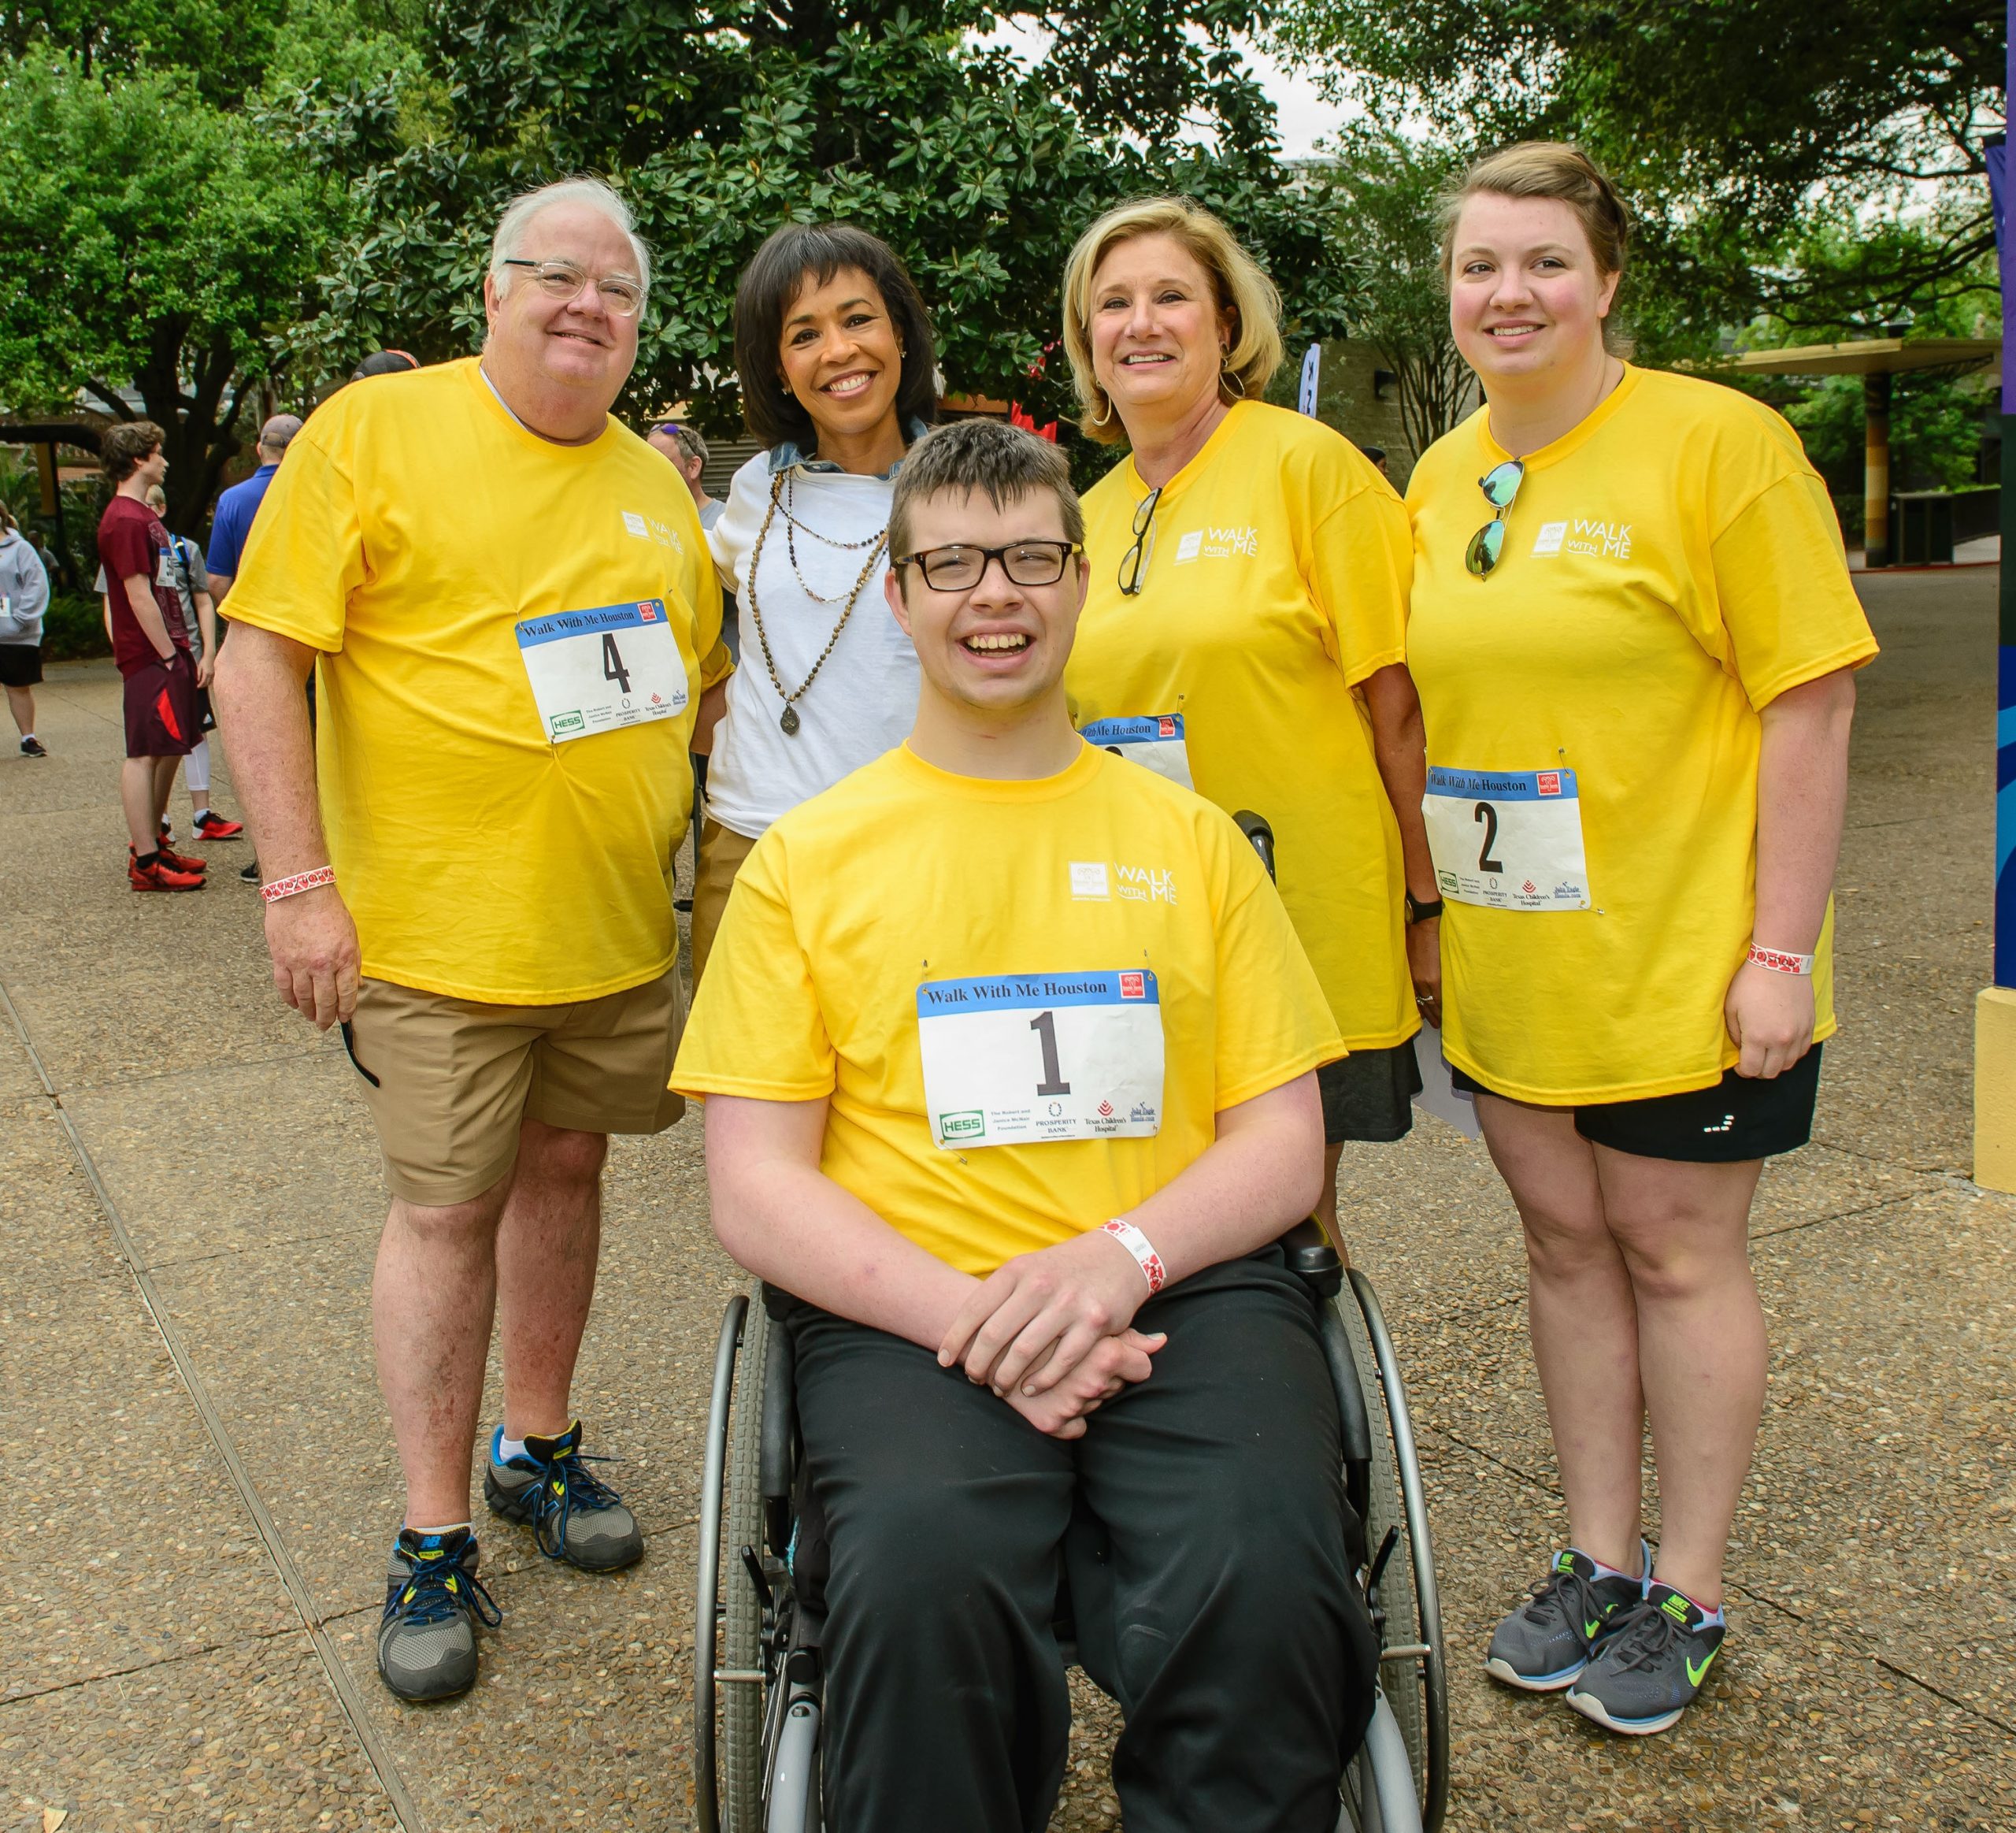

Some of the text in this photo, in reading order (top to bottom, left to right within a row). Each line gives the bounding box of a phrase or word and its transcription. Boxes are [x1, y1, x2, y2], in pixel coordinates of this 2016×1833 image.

[1208, 525, 1258, 544] WALK
[1574, 518, 1632, 543] WALK
[1203, 540, 1258, 558] WITH ME
[1567, 539, 1632, 559] WITH ME
[523, 622, 555, 637] Walk
[557, 617, 584, 630] With
[584, 614, 599, 625] Me
[600, 610, 635, 623] Houston
[602, 633, 632, 694] 4
[616, 708, 641, 718] PROSPERITY
[554, 716, 581, 730] HESS
[1096, 725, 1110, 737] Me
[1112, 724, 1151, 736] Houston
[1430, 774, 1528, 792] Walk With Me Houston
[1473, 801, 1503, 874] 2
[1113, 860, 1176, 889] WALK
[1442, 876, 1457, 888] HESS
[1117, 884, 1178, 906] WITH ME
[1483, 889, 1507, 898] PROSPERITY
[927, 981, 1107, 1004] Walk With Me Houston
[1030, 1011, 1071, 1096] 1
[944, 1118, 981, 1133] HESS
[1036, 1119, 1077, 1127] PROSPERITY
[1094, 1125, 1117, 1134] Hospital
[1101, 1116, 1127, 1125] Children's
